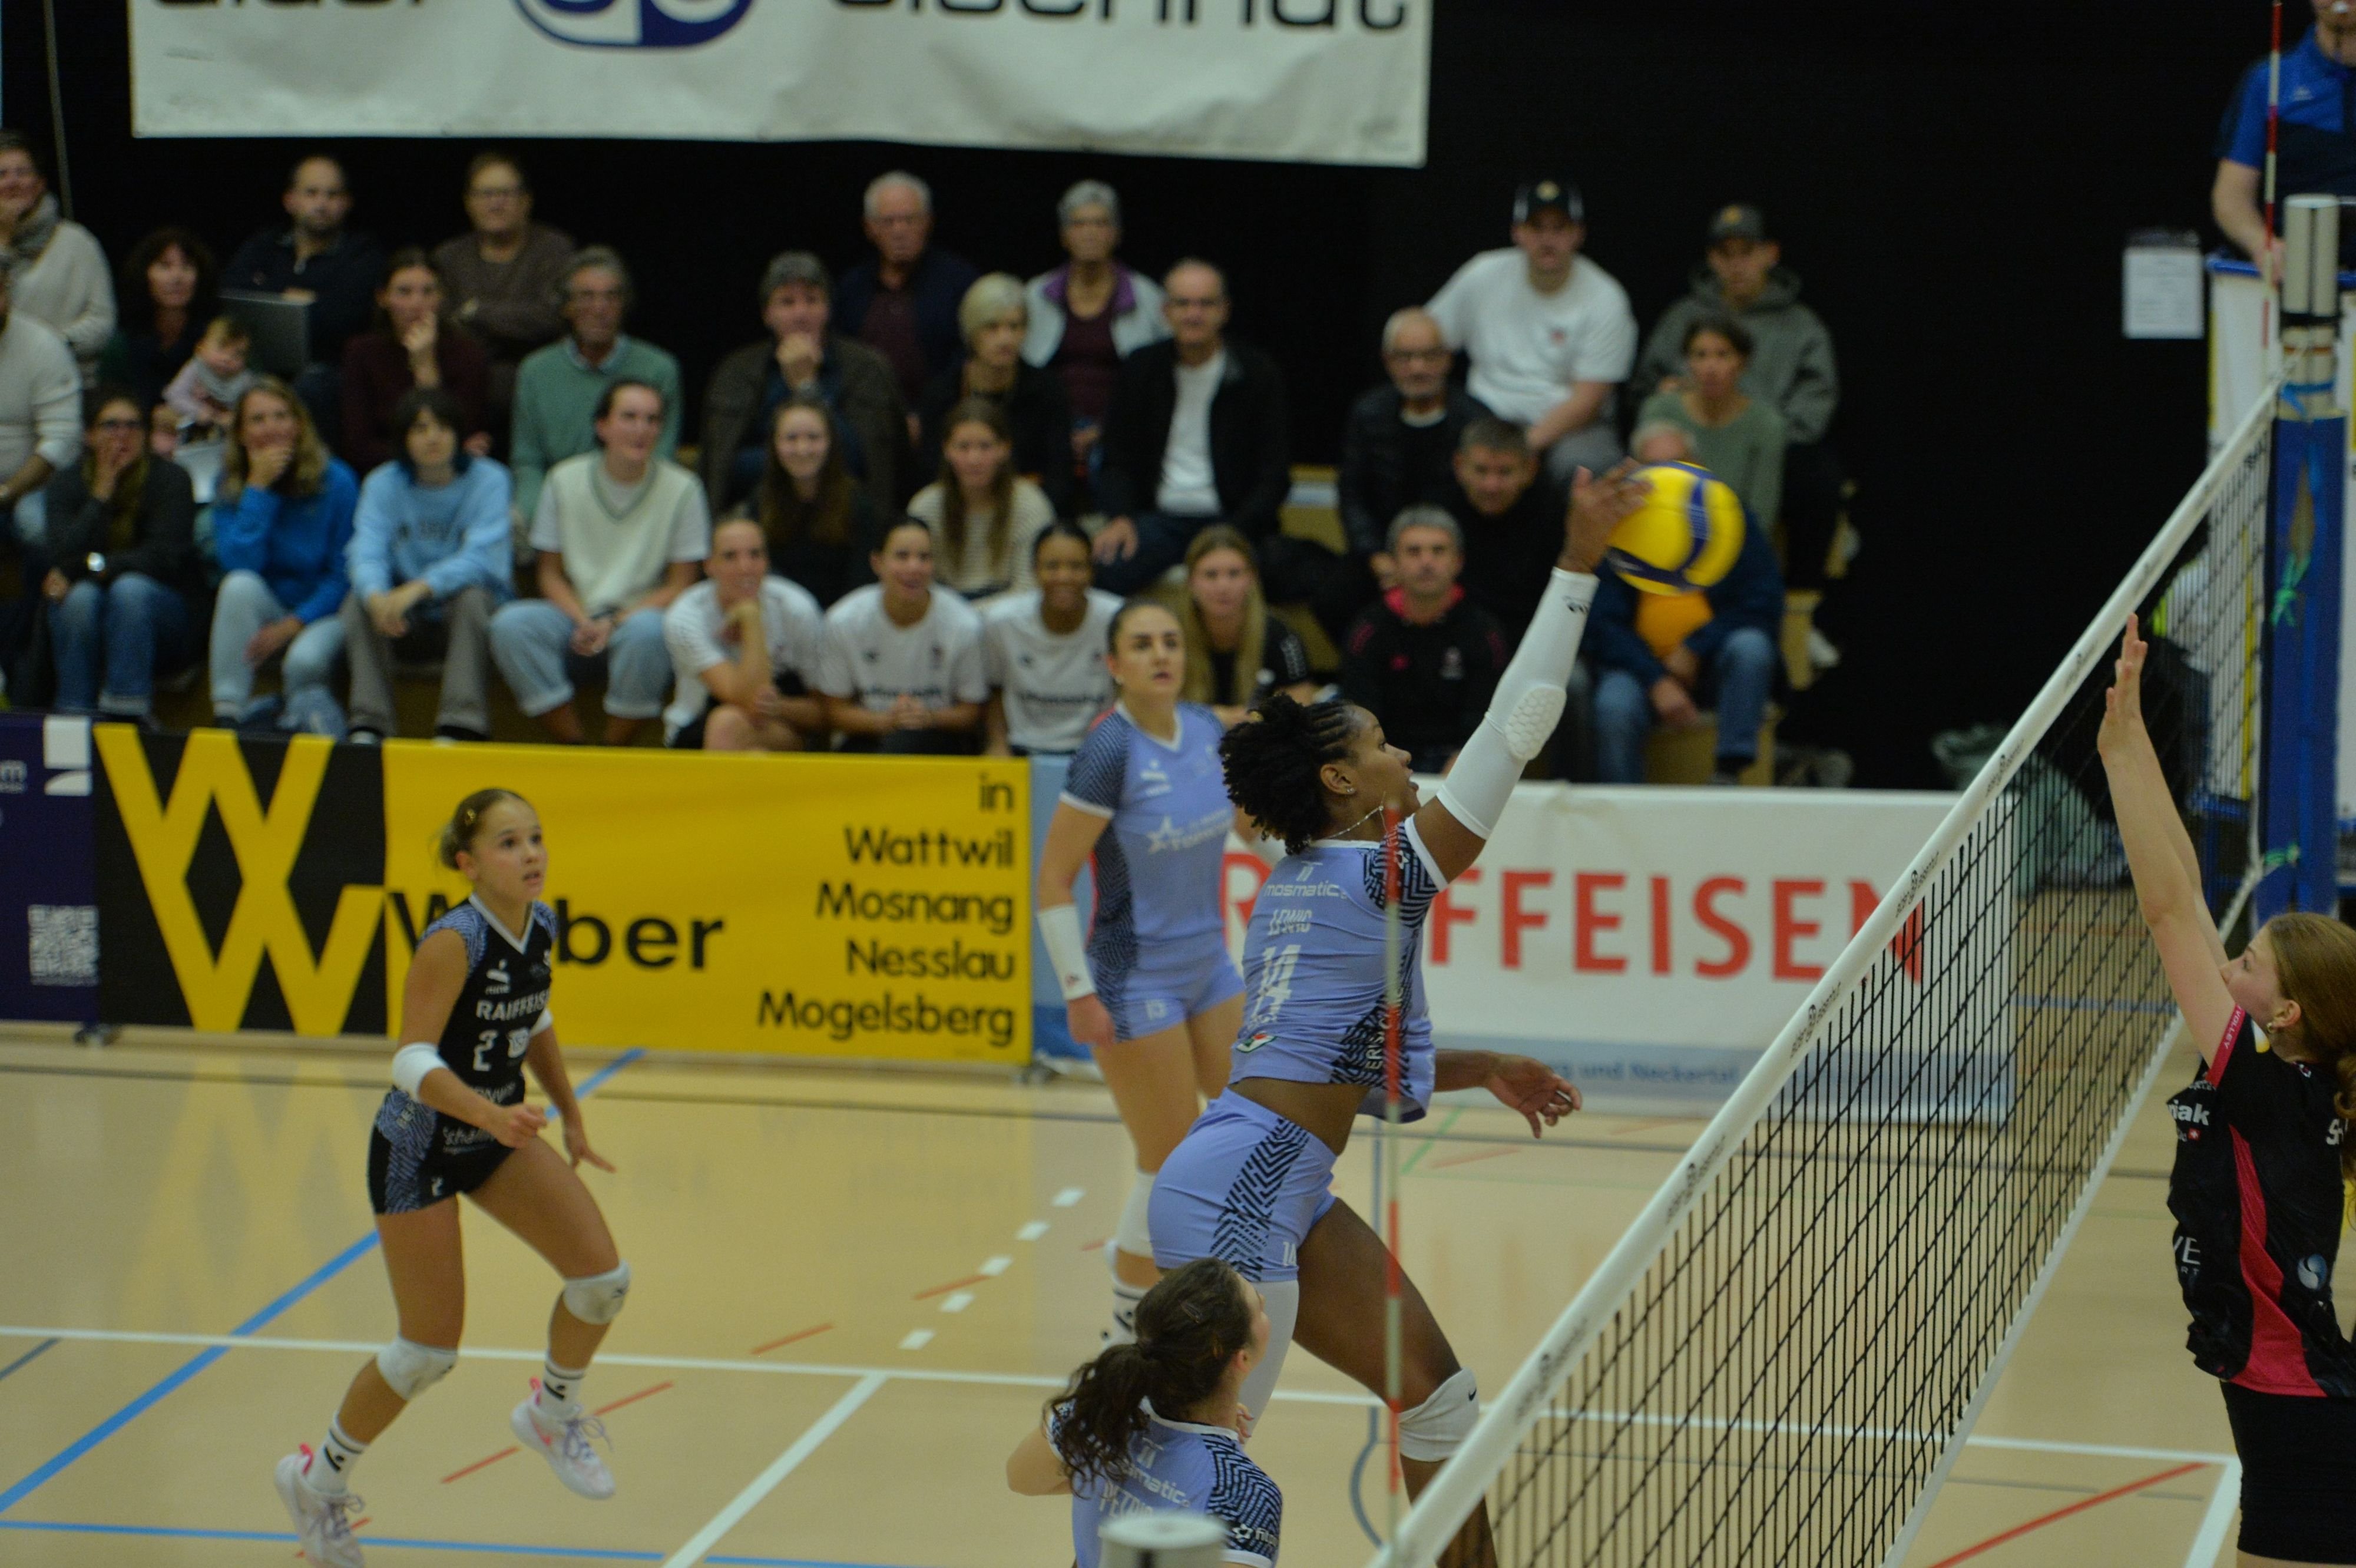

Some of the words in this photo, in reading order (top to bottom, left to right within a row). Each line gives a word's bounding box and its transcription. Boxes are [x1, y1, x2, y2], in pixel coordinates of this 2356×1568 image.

[979, 773, 1015, 813] in
[844, 826, 1015, 868] Wattwil
[816, 881, 1015, 935] Mosnang
[1265, 880, 1341, 897] mosmatic
[386, 892, 726, 972] Wber
[1219, 852, 1922, 983] RFFEISEN
[846, 938, 1015, 981] Nesslau
[757, 990, 1016, 1049] Mogelsberg
[473, 1030, 499, 1072] 2
